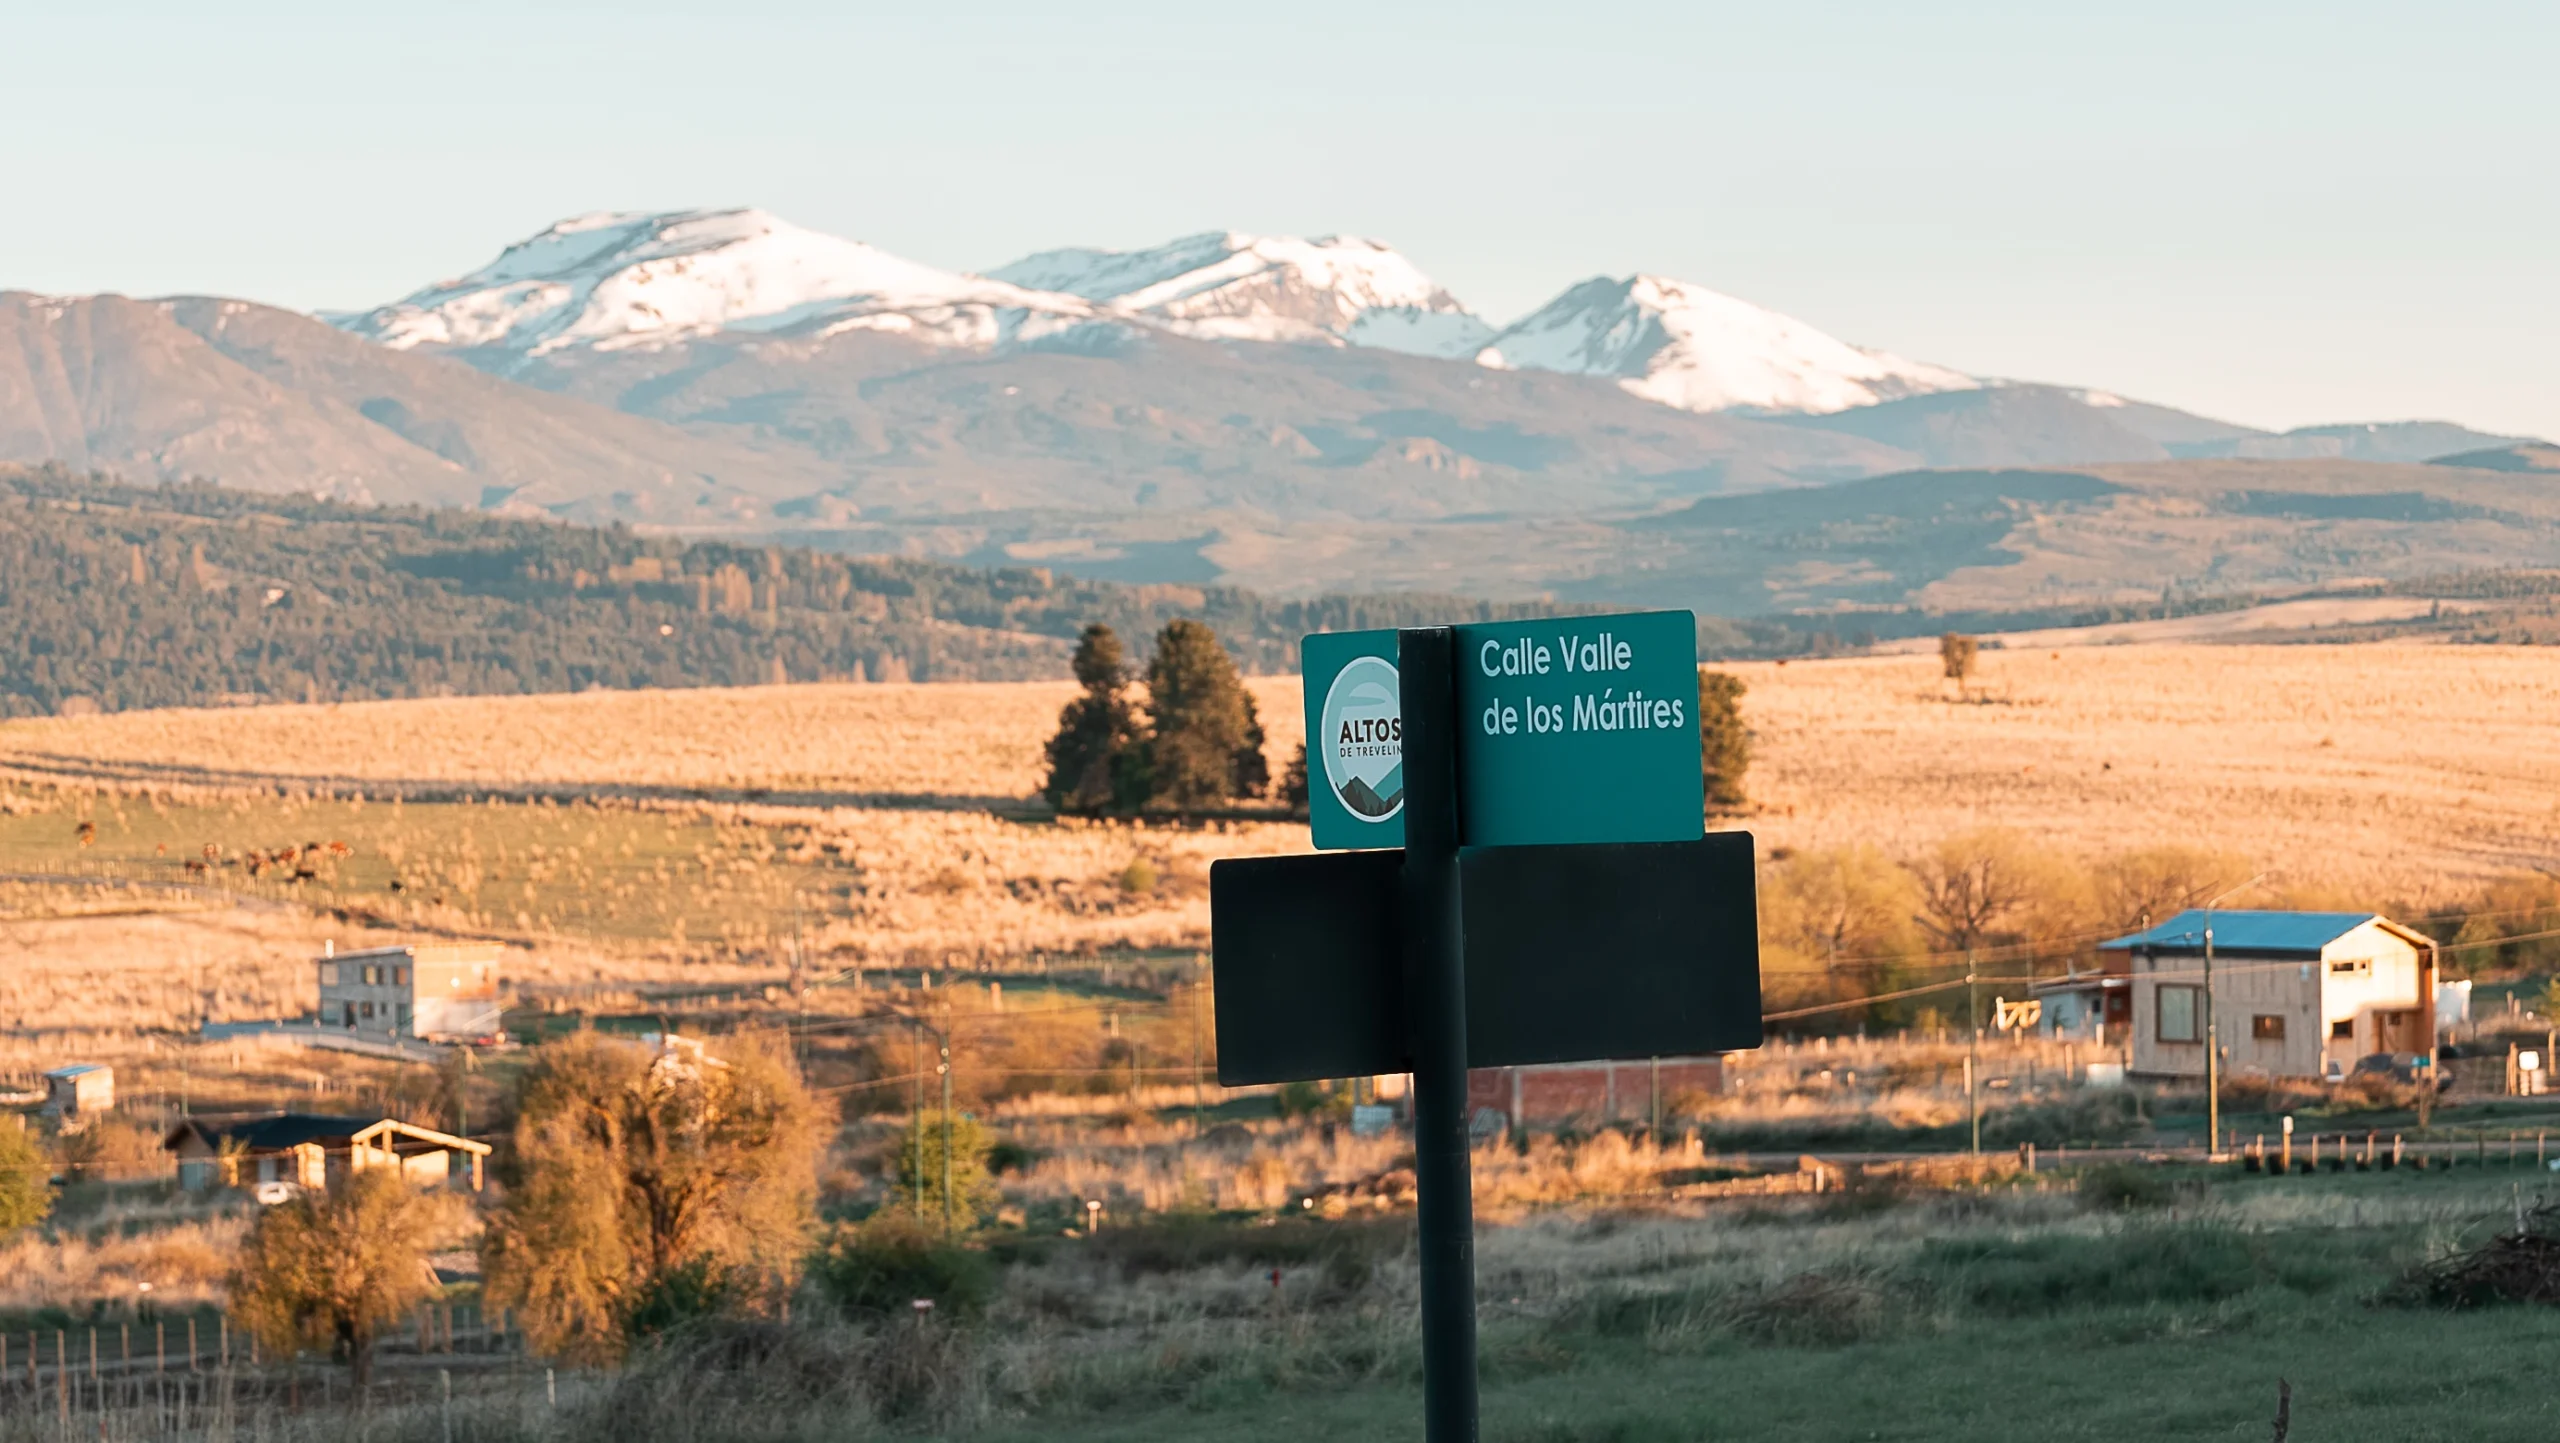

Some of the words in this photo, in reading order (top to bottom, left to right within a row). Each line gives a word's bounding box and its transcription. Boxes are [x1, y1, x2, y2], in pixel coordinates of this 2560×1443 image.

[1480, 637, 1551, 677] Calle
[1559, 633, 1632, 672] Valle
[1483, 698, 1518, 735] de
[1527, 696, 1564, 733] los
[1573, 688, 1684, 732] Mártires
[1339, 717, 1401, 744] ALTOS
[1340, 747, 1352, 758] DE
